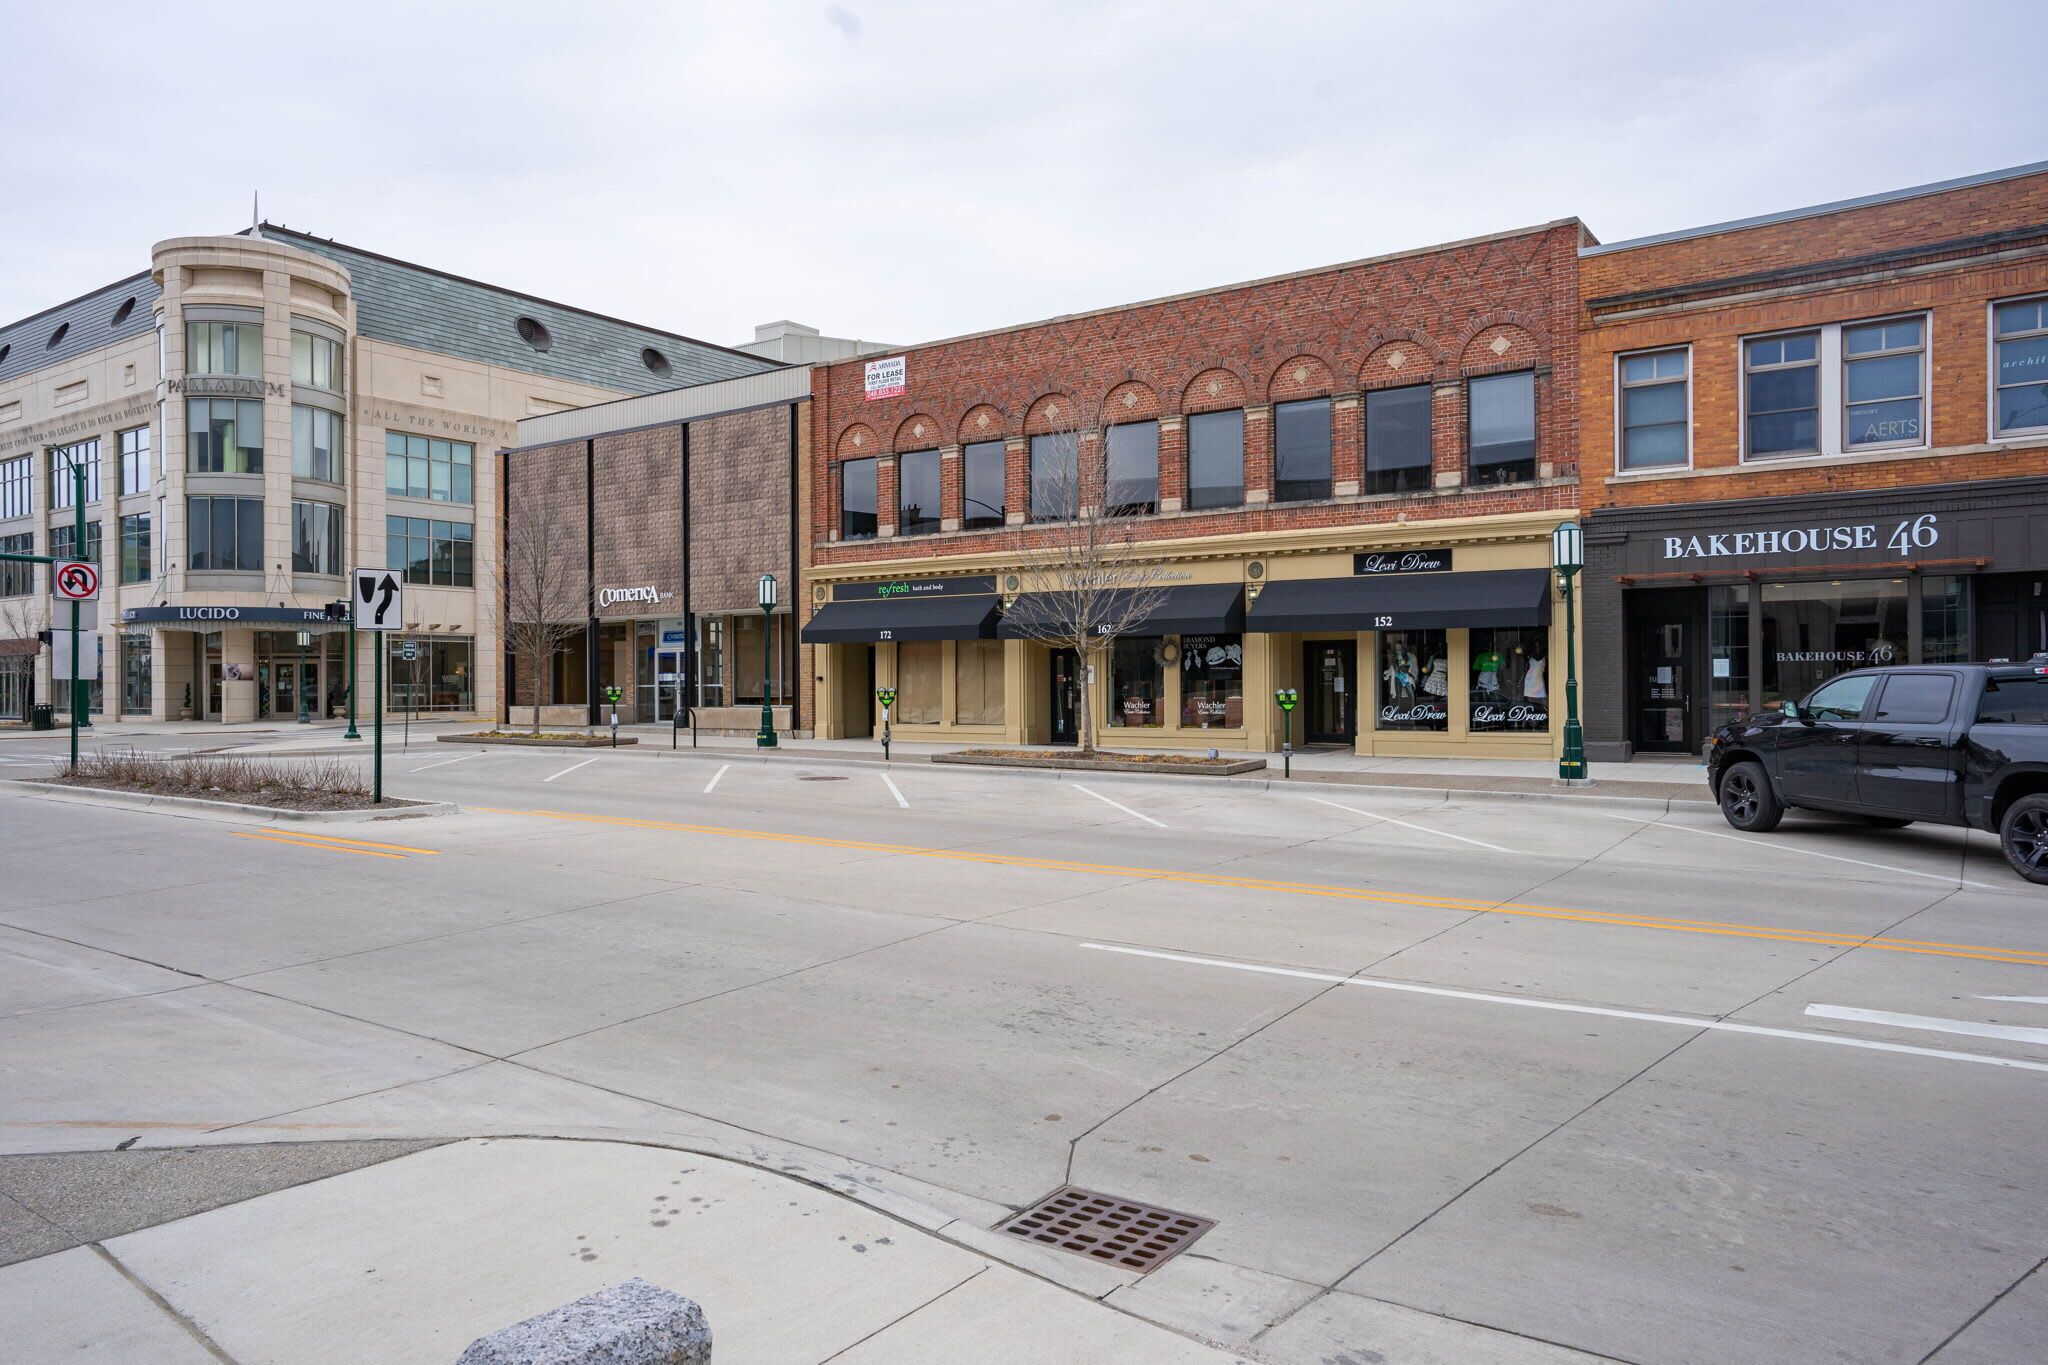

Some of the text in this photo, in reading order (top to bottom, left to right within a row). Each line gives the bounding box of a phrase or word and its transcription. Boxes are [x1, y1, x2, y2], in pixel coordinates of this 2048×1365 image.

[878, 360, 901, 370] ARMADA
[867, 369, 904, 381] FOR LEASE
[29, 433, 44, 444] THEM
[57, 423, 79, 436] LEGACY
[80, 421, 87, 430] IS
[88, 418, 96, 427] SO
[97, 414, 113, 425] RICH
[114, 411, 123, 421] AS
[123, 403, 152, 419] HONESTY
[374, 410, 399, 422] ALL
[409, 415, 434, 427] THE
[443, 421, 496, 438] WORLD'S
[1864, 418, 1918, 440] AERTS
[1663, 514, 1939, 559] BAKEHOUSE 46
[1363, 552, 1441, 572] Lexi Drew
[660, 591, 674, 599] BANK
[878, 580, 910, 599] refresh
[932, 583, 944, 592] body
[179, 607, 240, 620] LUCIDO
[303, 611, 325, 621] FINE
[1374, 615, 1393, 627] 152
[880, 630, 892, 639] 172
[1097, 624, 1112, 634] 162
[1776, 644, 1893, 665] BAKEHOUSE 46
[1124, 701, 1150, 709] Wachler
[1197, 701, 1226, 709] Wachler
[1380, 704, 1447, 721] Lexi Drew
[1472, 705, 1548, 722] Lexi Drew
